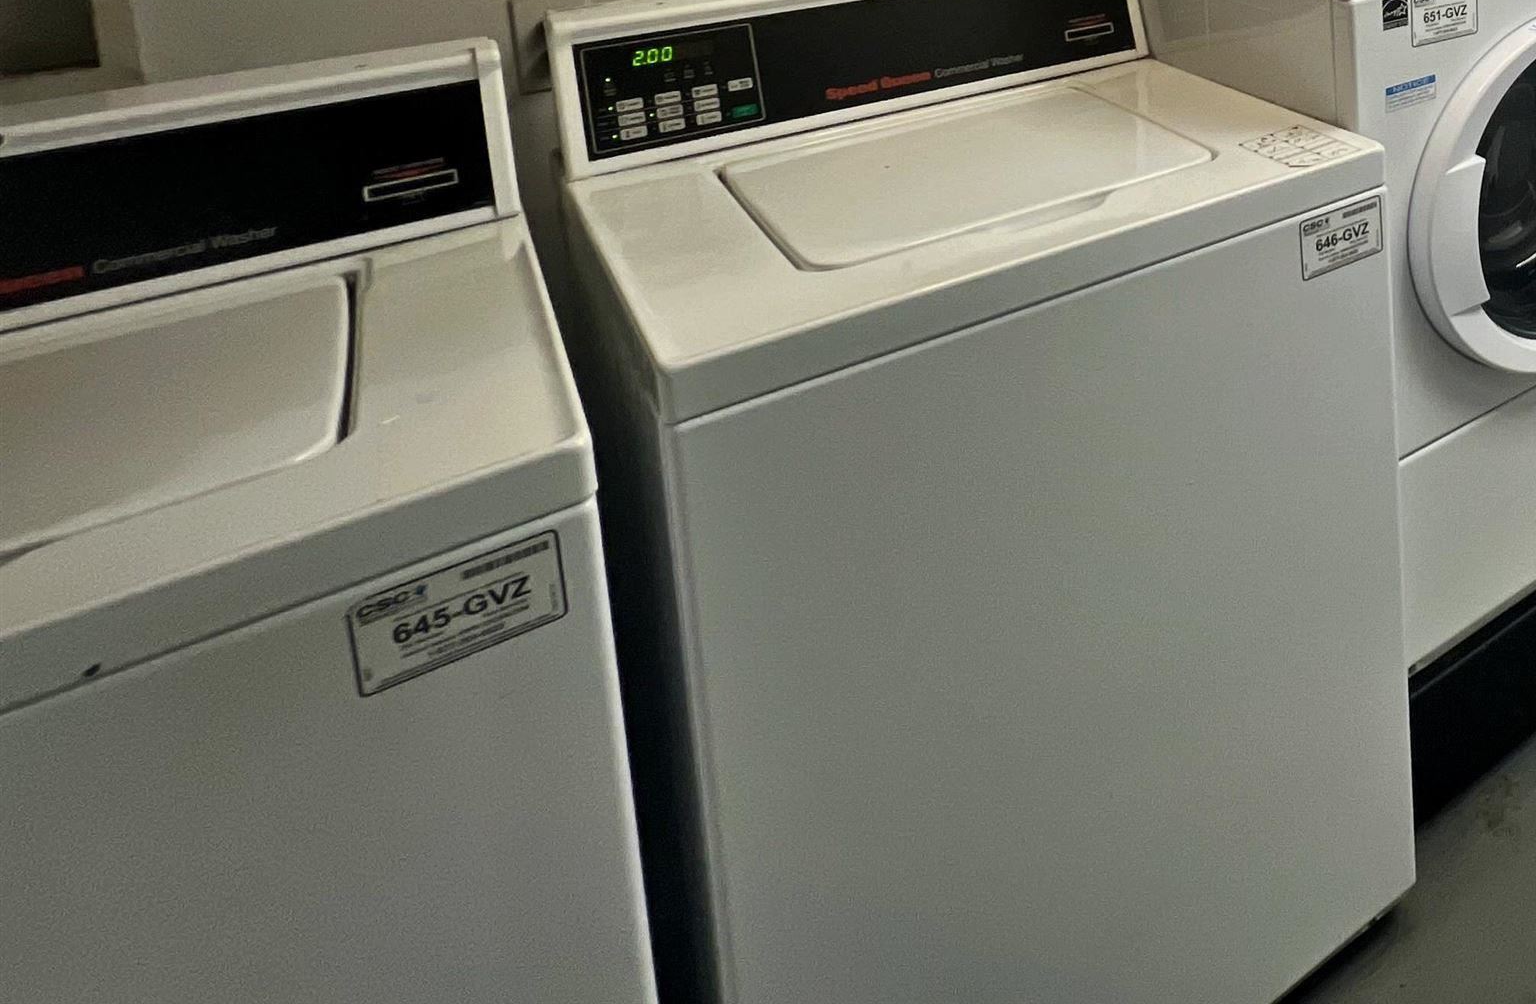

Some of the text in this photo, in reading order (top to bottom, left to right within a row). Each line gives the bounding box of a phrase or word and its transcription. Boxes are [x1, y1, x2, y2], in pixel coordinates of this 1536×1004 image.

[1423, 4, 1468, 23] 651-GVZ
[632, 46, 673, 67] 2.00
[1302, 220, 1324, 233] CSC
[1315, 221, 1370, 252] 646-GVZ
[356, 590, 412, 619] CSC
[392, 575, 532, 644] 645-GVZ
